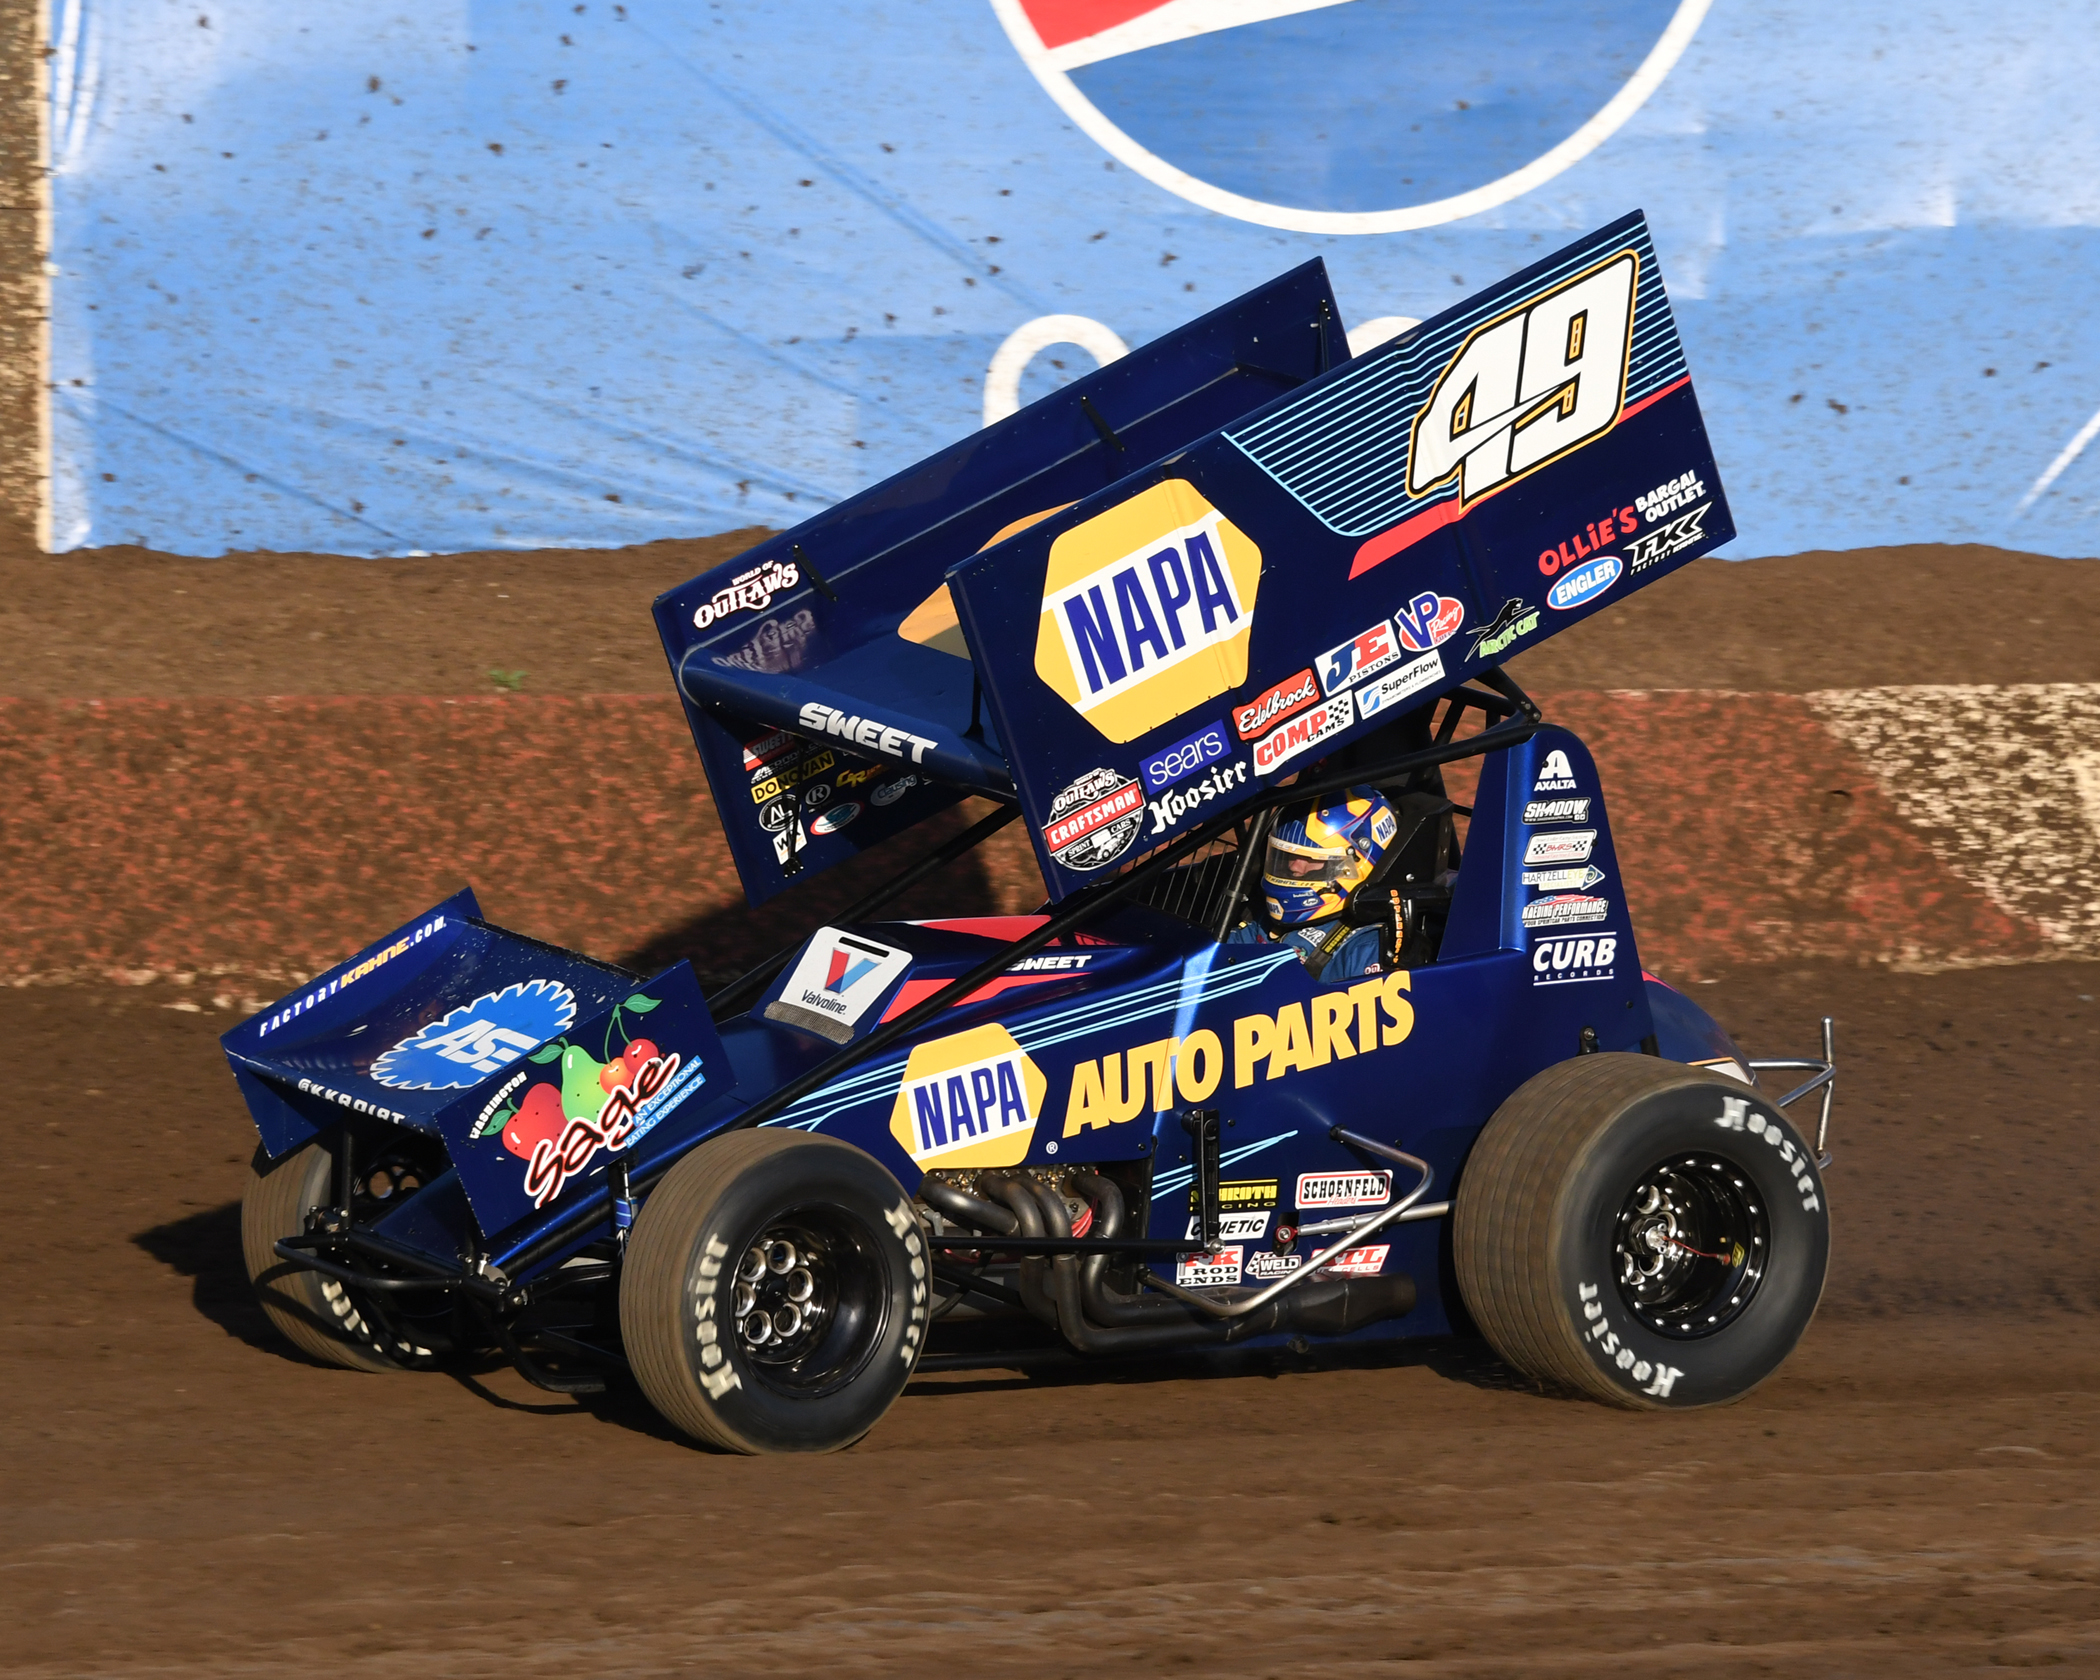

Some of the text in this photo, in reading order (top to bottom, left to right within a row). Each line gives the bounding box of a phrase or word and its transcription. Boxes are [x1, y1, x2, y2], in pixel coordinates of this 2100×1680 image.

[1407, 250, 1639, 512] 49
[1645, 480, 1705, 522] OUTLET
[732, 560, 774, 586] WORLD OF
[1555, 560, 1616, 605] ENGLER
[693, 562, 799, 629] OUTLAWS
[1063, 531, 1239, 694] NAPA
[1397, 593, 1439, 649] VP
[1431, 605, 1461, 638] Racing
[1479, 611, 1540, 658] ARCTIC CAT
[1326, 623, 1390, 692] JE
[1349, 652, 1399, 683] PISTONS
[1381, 658, 1438, 695] SuperFlow
[1238, 675, 1316, 733] Edelbrock
[799, 702, 939, 764] SWEET
[1256, 710, 1327, 766] COMP
[1307, 717, 1346, 742] CAMS
[754, 753, 833, 801] DONOVAN
[1149, 732, 1222, 785] sears
[877, 774, 917, 798] Clausing
[1053, 772, 1115, 811] OUTLAWS
[1148, 761, 1247, 835] Hoosier
[1534, 779, 1577, 791] AXALTA
[1050, 789, 1136, 845] CRAFTSMAN
[1376, 815, 1396, 841] NAPA
[1524, 799, 1588, 818] SHADOW
[1067, 819, 1131, 857] SPRINT CARS
[1554, 901, 1607, 917] PERFORMANCE
[1006, 955, 1092, 971] SWEET
[1533, 938, 1617, 972] CURB
[1534, 968, 1614, 981] RECORDS
[801, 989, 846, 1015] Valvoline
[1062, 970, 1414, 1138] AUTO PARTS
[469, 1071, 527, 1139] WASHINGTON
[626, 1076, 703, 1146] EATING EXPERIENCE
[635, 1059, 700, 1125] AN EXCEPTIONAL
[914, 1060, 1026, 1150] NAPA
[1715, 1096, 1820, 1213] Hoosier
[1190, 1185, 1277, 1202] SHROTH
[1303, 1178, 1386, 1199] SCHOENFELD
[1190, 1219, 1265, 1236] CMETIC
[1179, 1275, 1238, 1285] ENDS
[1192, 1265, 1238, 1275] ROD
[1260, 1258, 1299, 1270] WELD
[694, 1233, 742, 1400] Hoosier
[1579, 1282, 1685, 1398] Hoosier
